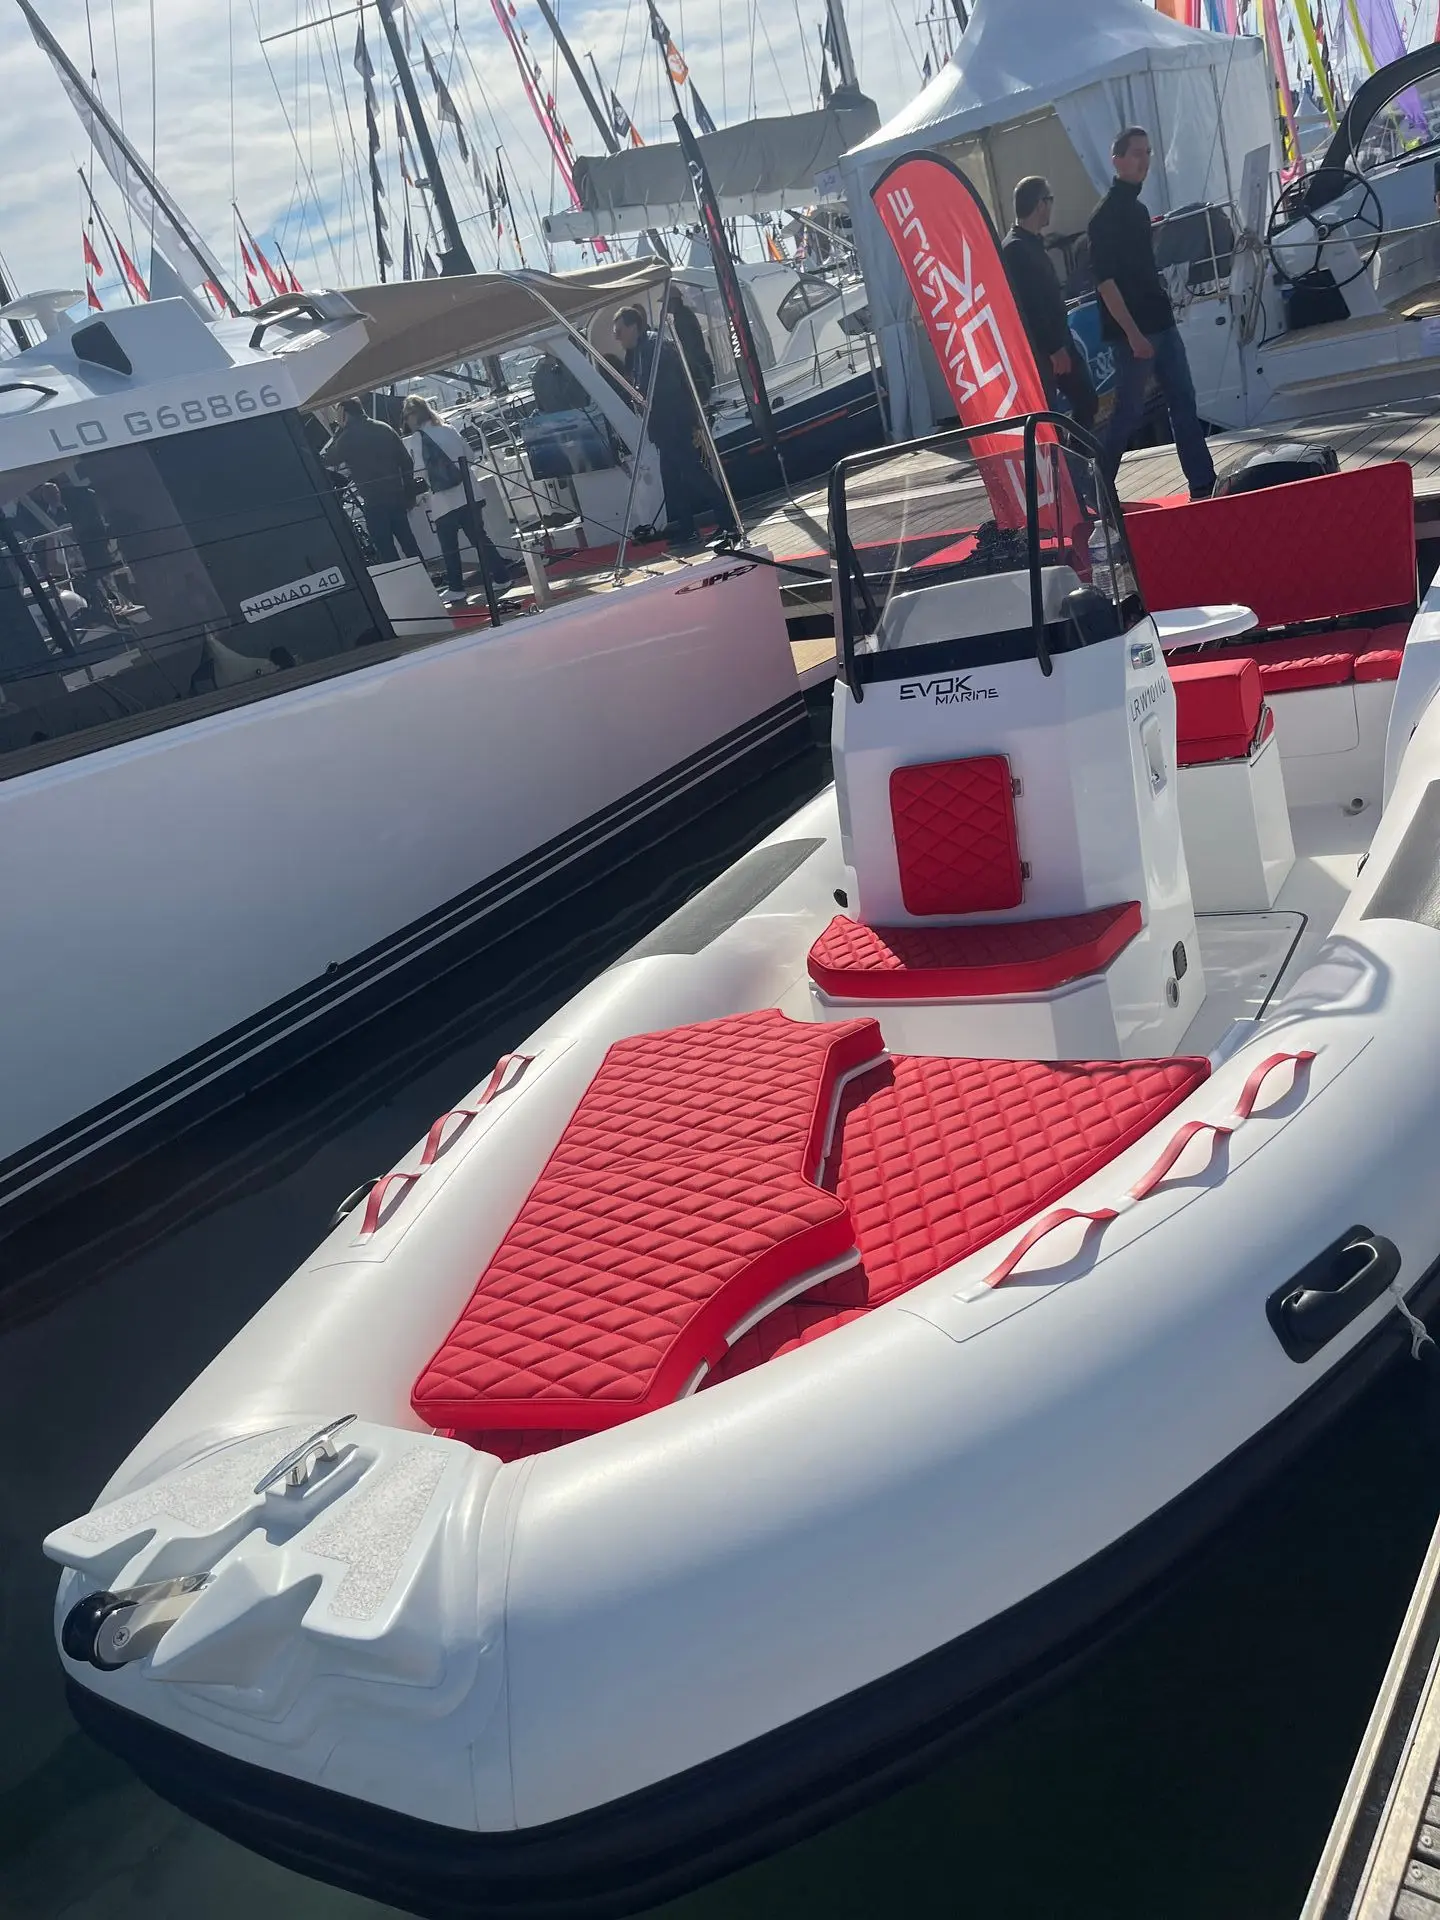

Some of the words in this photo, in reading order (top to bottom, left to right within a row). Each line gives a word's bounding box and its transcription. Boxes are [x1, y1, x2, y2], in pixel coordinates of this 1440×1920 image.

[49, 420, 108, 452] LO
[123, 384, 282, 436] G68866
[246, 583, 312, 617] NOMAD
[318, 573, 340, 588] 40
[900, 675, 973, 700] EVOK
[935, 688, 999, 706] MARINE
